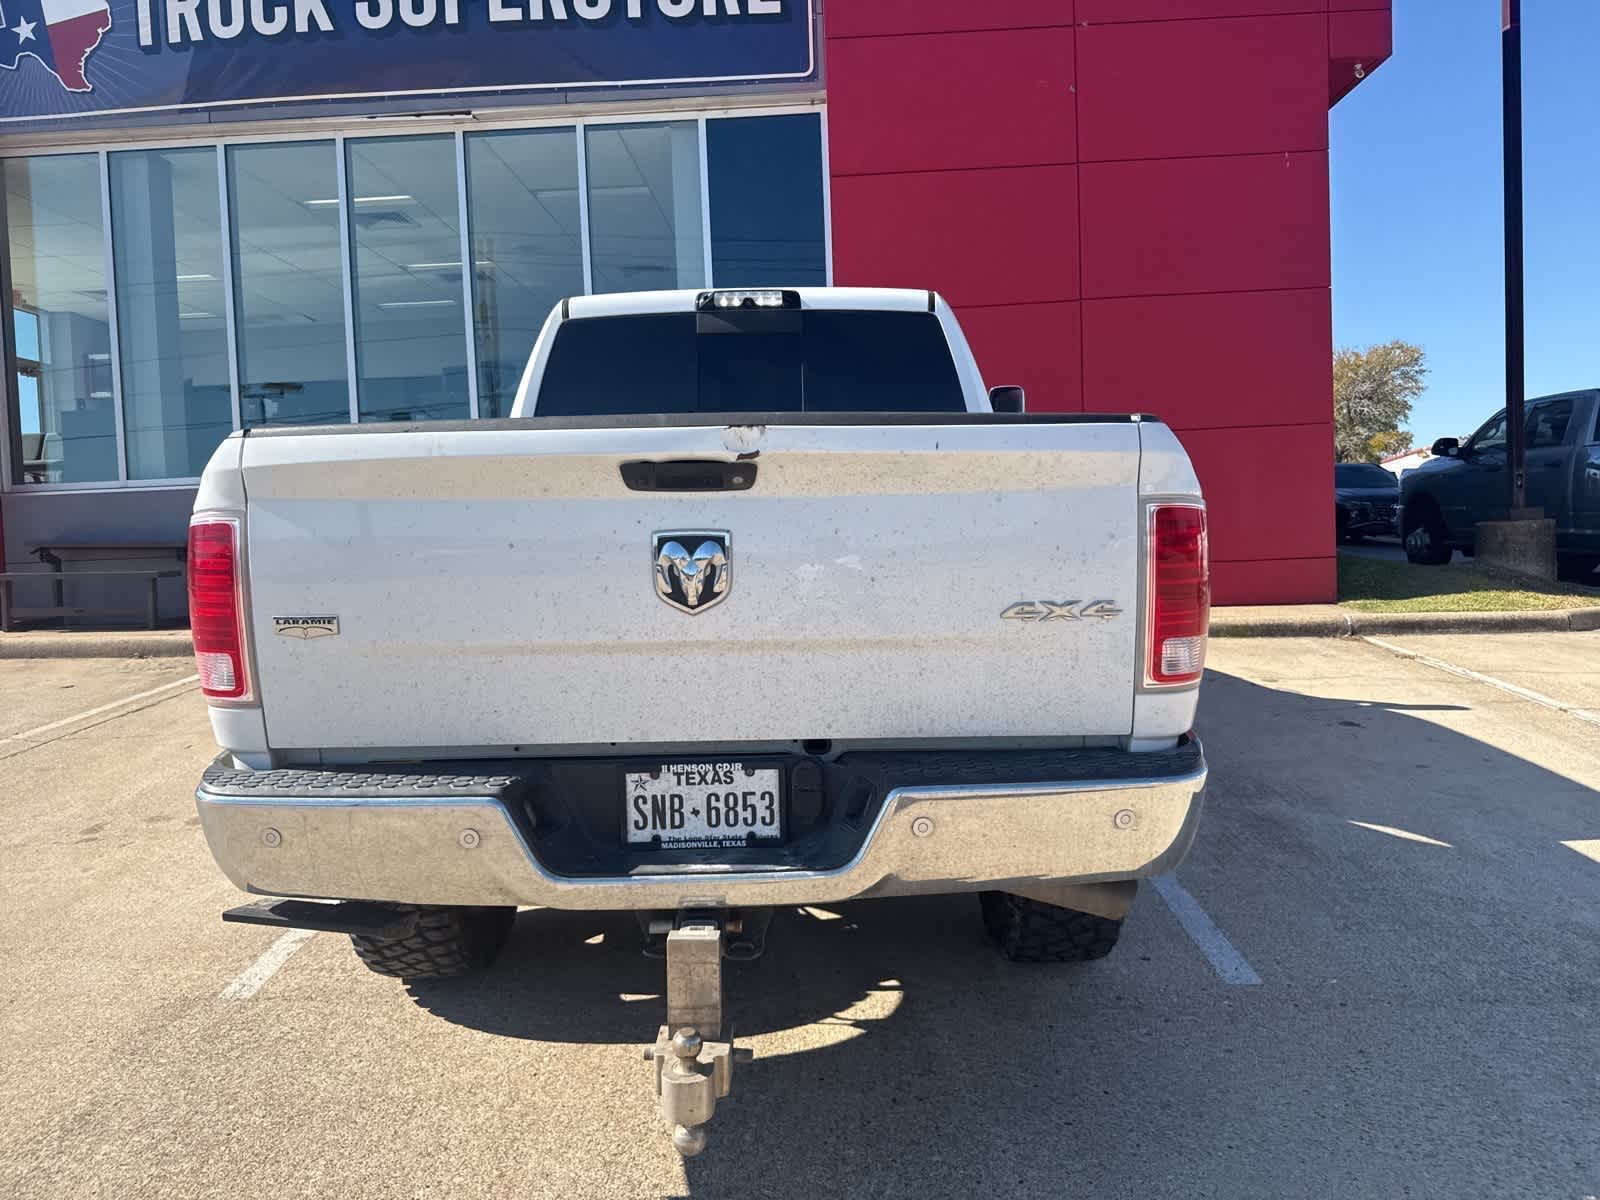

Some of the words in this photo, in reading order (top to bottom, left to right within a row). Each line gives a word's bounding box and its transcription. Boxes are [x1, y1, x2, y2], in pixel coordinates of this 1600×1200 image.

[275, 617, 335, 625] LARAMIE
[670, 763, 713, 773] HENSON
[715, 762, 742, 772] CDJR
[673, 770, 735, 786] TEXAS
[633, 793, 685, 831] SNB
[706, 791, 775, 828] 6853
[722, 839, 746, 848] TEXAS
